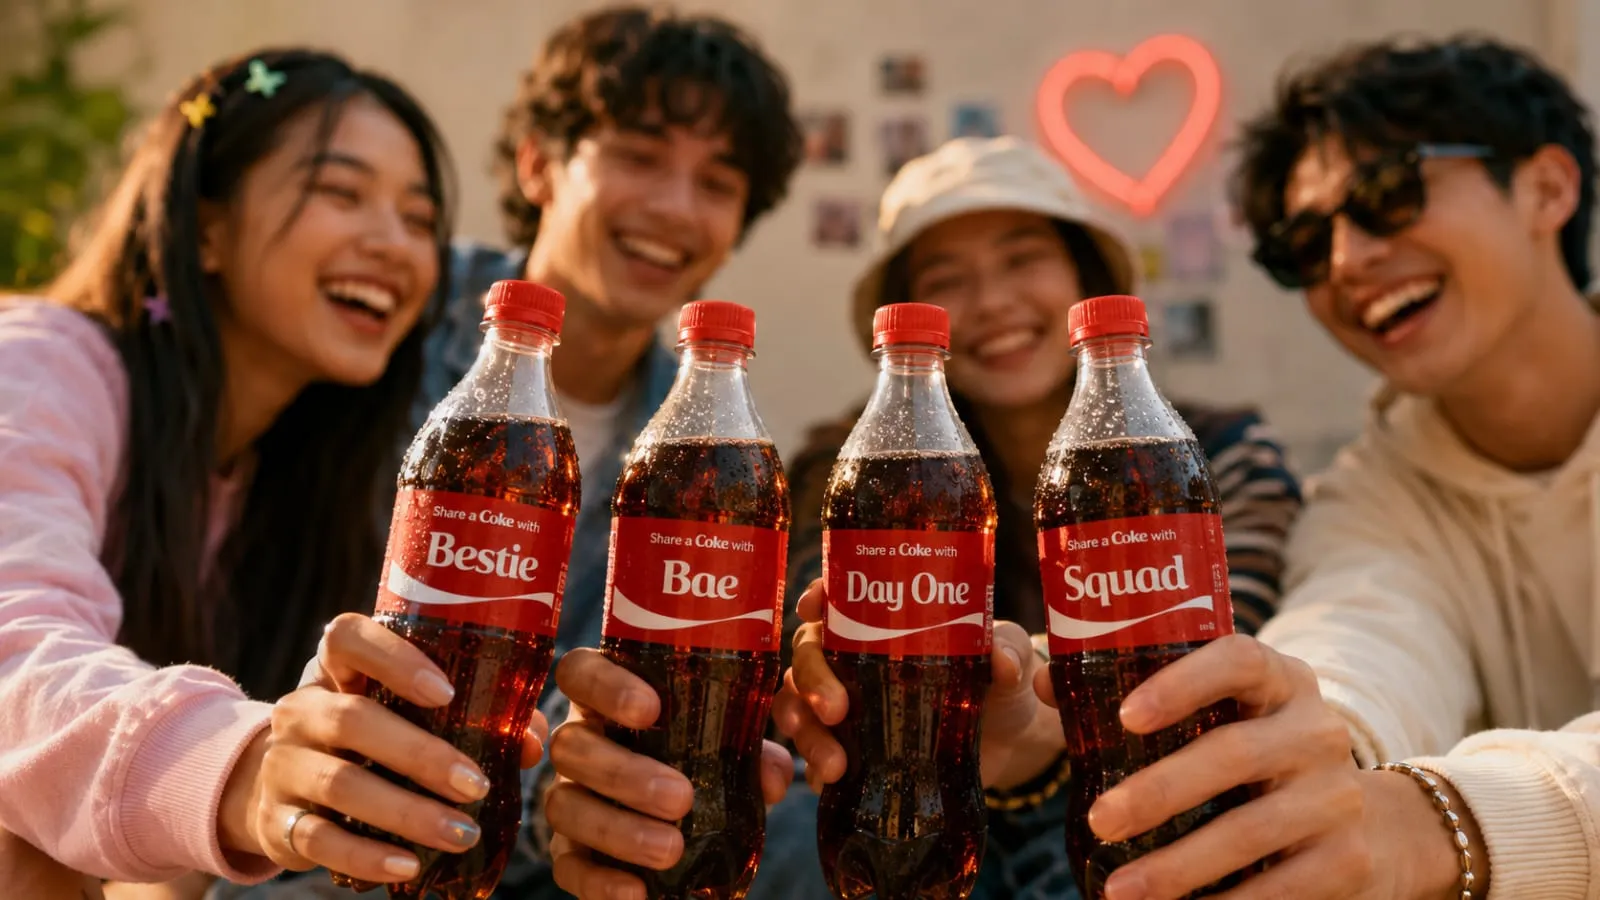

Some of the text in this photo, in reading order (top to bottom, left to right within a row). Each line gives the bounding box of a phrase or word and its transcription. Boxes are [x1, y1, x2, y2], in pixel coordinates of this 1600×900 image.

[433, 505, 540, 533] Share a Coke with
[426, 531, 539, 582] Bestie
[650, 532, 754, 553] Share a Coke with
[856, 543, 958, 557] Share a Coke with
[1068, 529, 1177, 551] Share a Coke with
[662, 559, 739, 600] Bae
[846, 570, 970, 611] Day One
[1063, 554, 1189, 607] Squad
